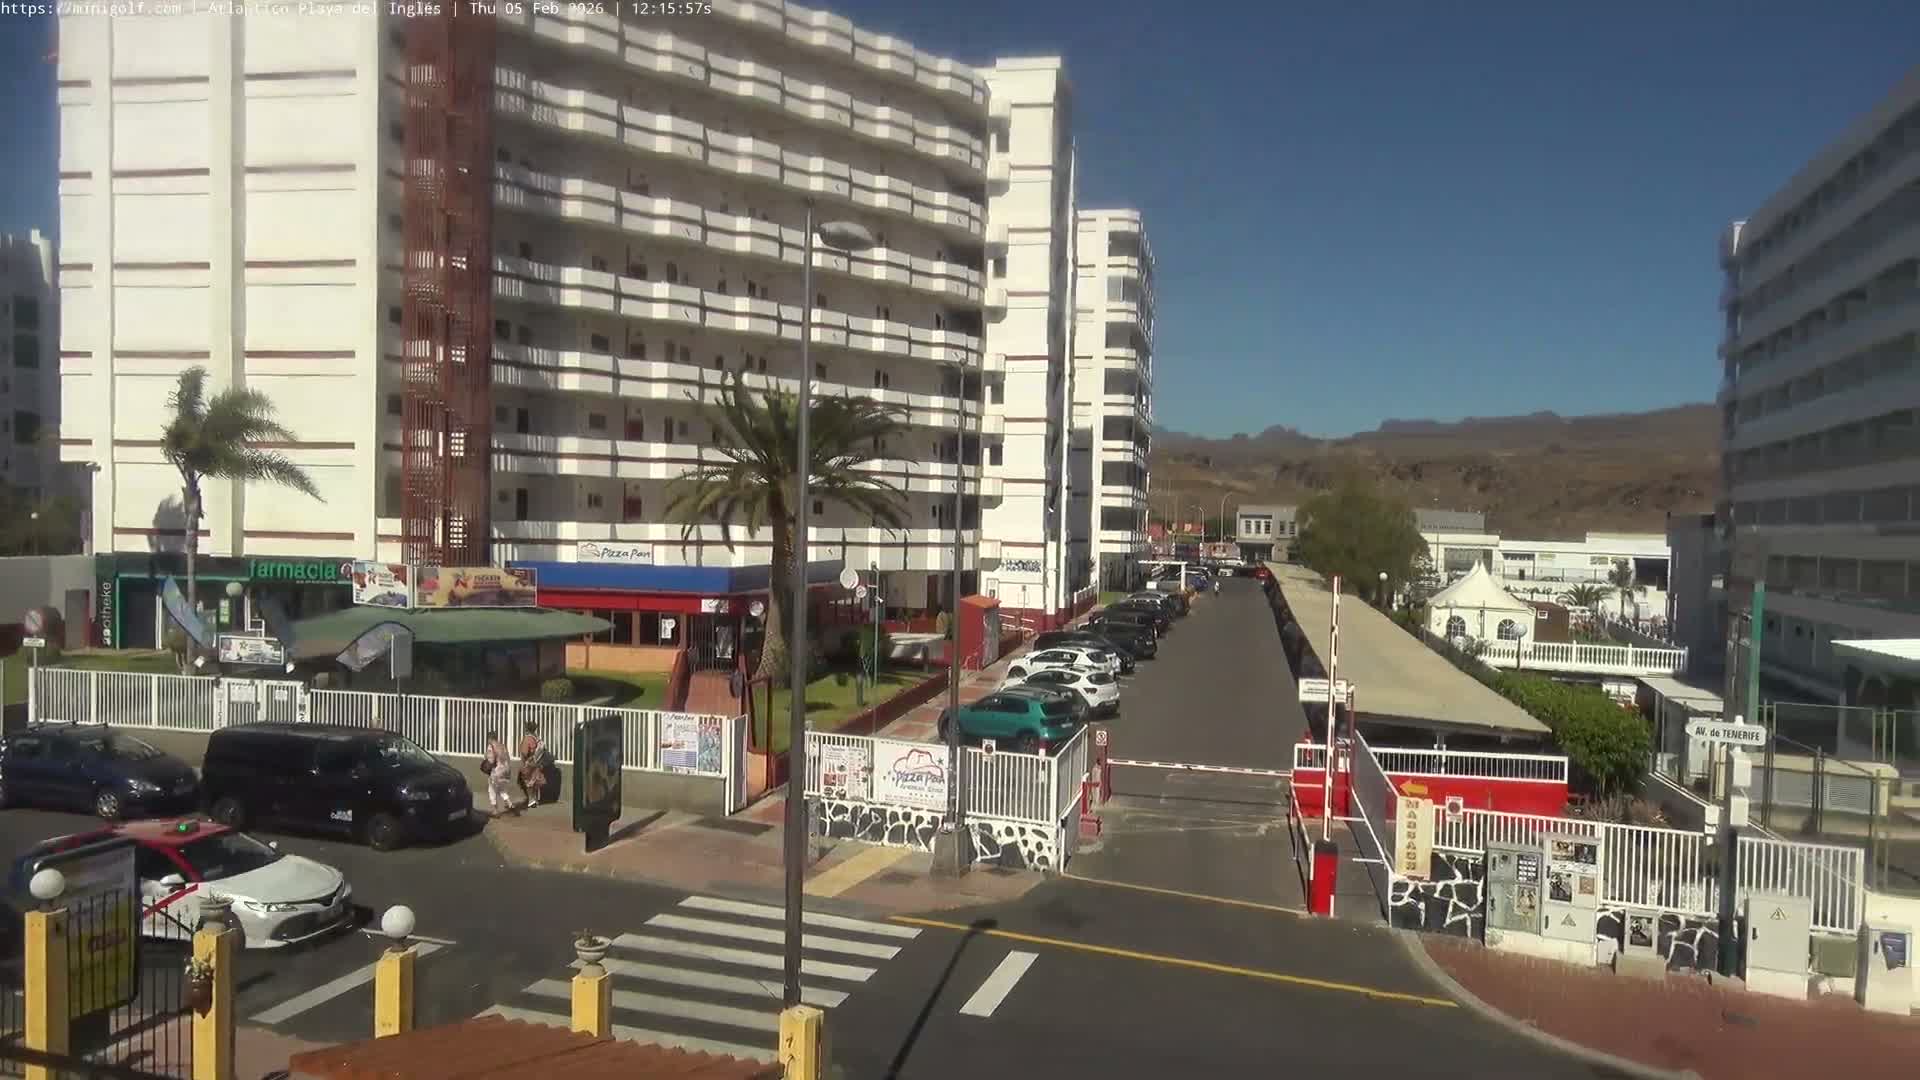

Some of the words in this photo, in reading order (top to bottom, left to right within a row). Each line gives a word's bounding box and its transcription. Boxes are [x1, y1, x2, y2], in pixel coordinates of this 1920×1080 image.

[601, 547, 629, 559] Pizza
[630, 548, 651, 560] Pan
[250, 559, 337, 580] farmacia
[1695, 727, 1708, 736] AV.
[1710, 729, 1720, 738] de
[1723, 730, 1760, 742] TENERIFE
